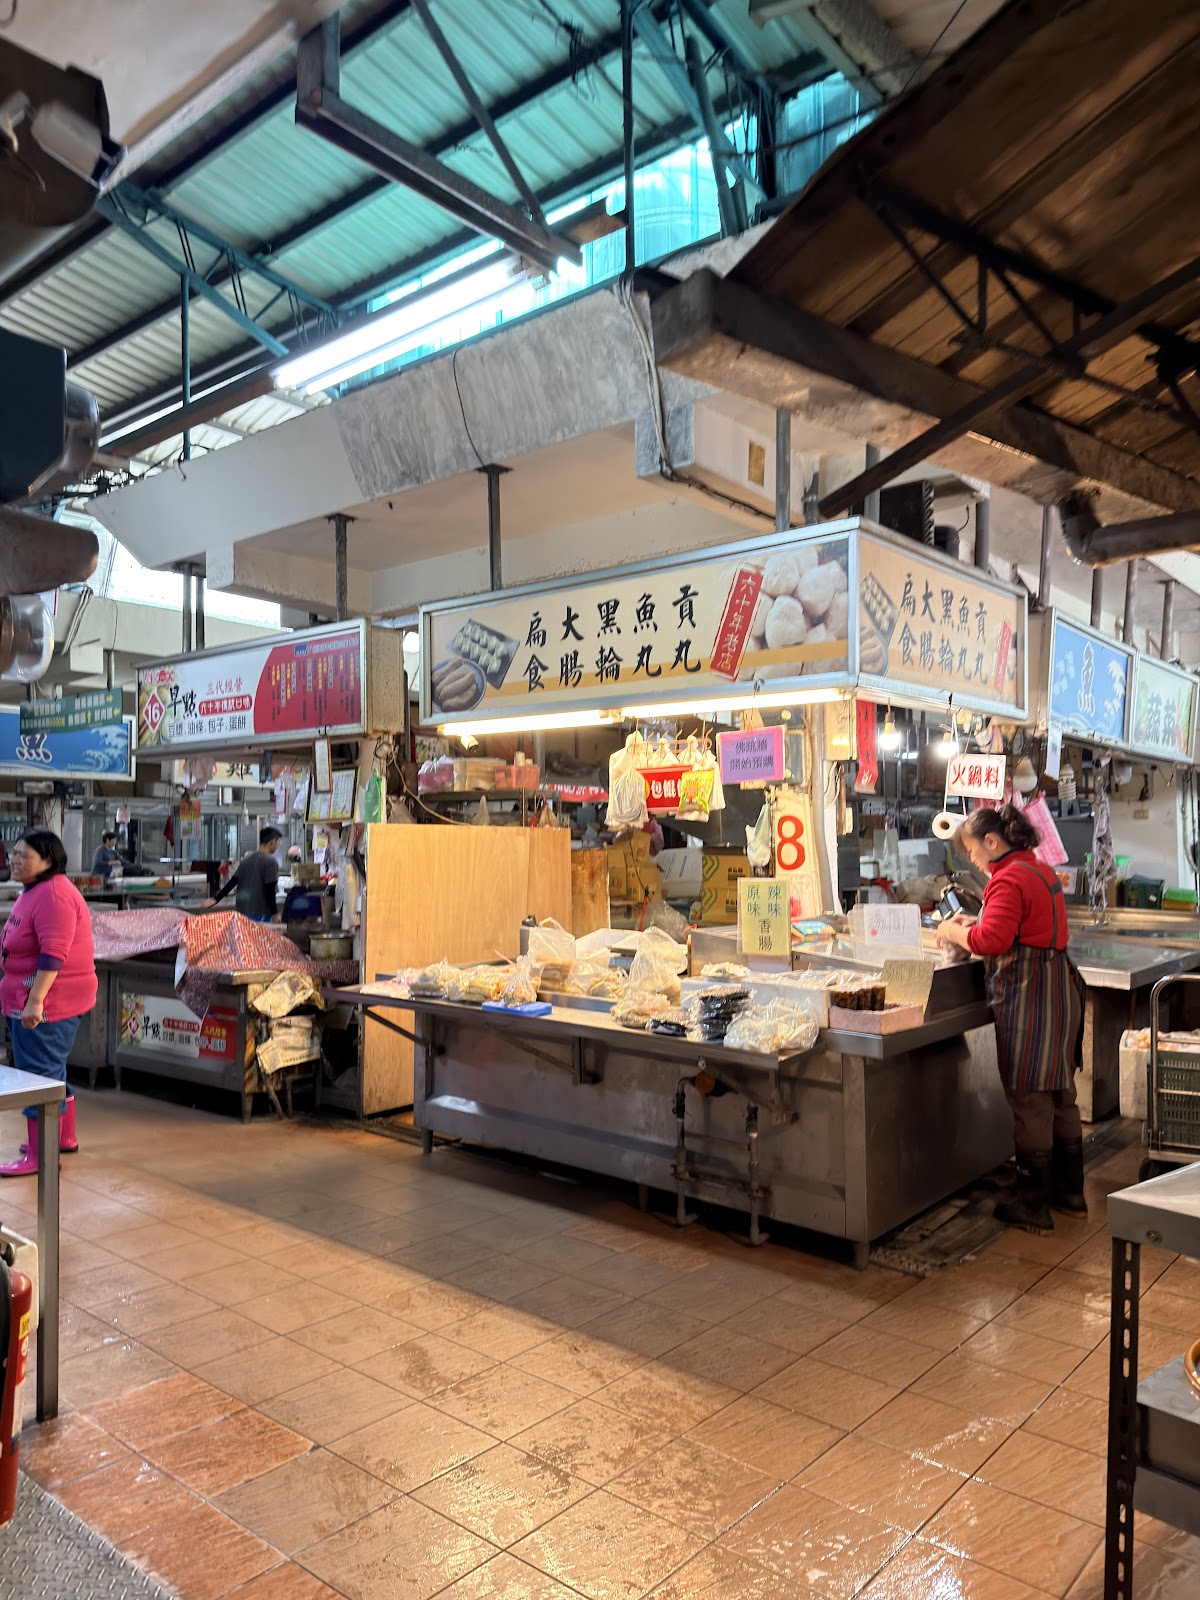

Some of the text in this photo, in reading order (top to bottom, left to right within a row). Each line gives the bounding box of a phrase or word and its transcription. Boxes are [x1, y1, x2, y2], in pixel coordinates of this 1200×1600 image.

[523, 611, 550, 692] 扁食
[559, 606, 584, 687] 大腸
[595, 598, 622, 681] 黑輪
[632, 592, 662, 677] 魚丸
[671, 585, 702, 675] 貢丸
[716, 575, 759, 671] 六十年老店
[898, 572, 917, 666] 扁食
[919, 580, 935, 672] 大腸
[938, 588, 955, 676] 黑輪
[956, 594, 972, 681] 魚丸
[973, 601, 988, 685] 貢丸
[146, 702, 161, 724] 16
[167, 685, 198, 719] 早點
[206, 676, 243, 696] 三代經營
[952, 762, 999, 789] 火鍋料
[777, 815, 806, 871] 8
[747, 884, 762, 917] 原味
[758, 918, 773, 952] 香腸
[767, 884, 782, 917] 辣味
